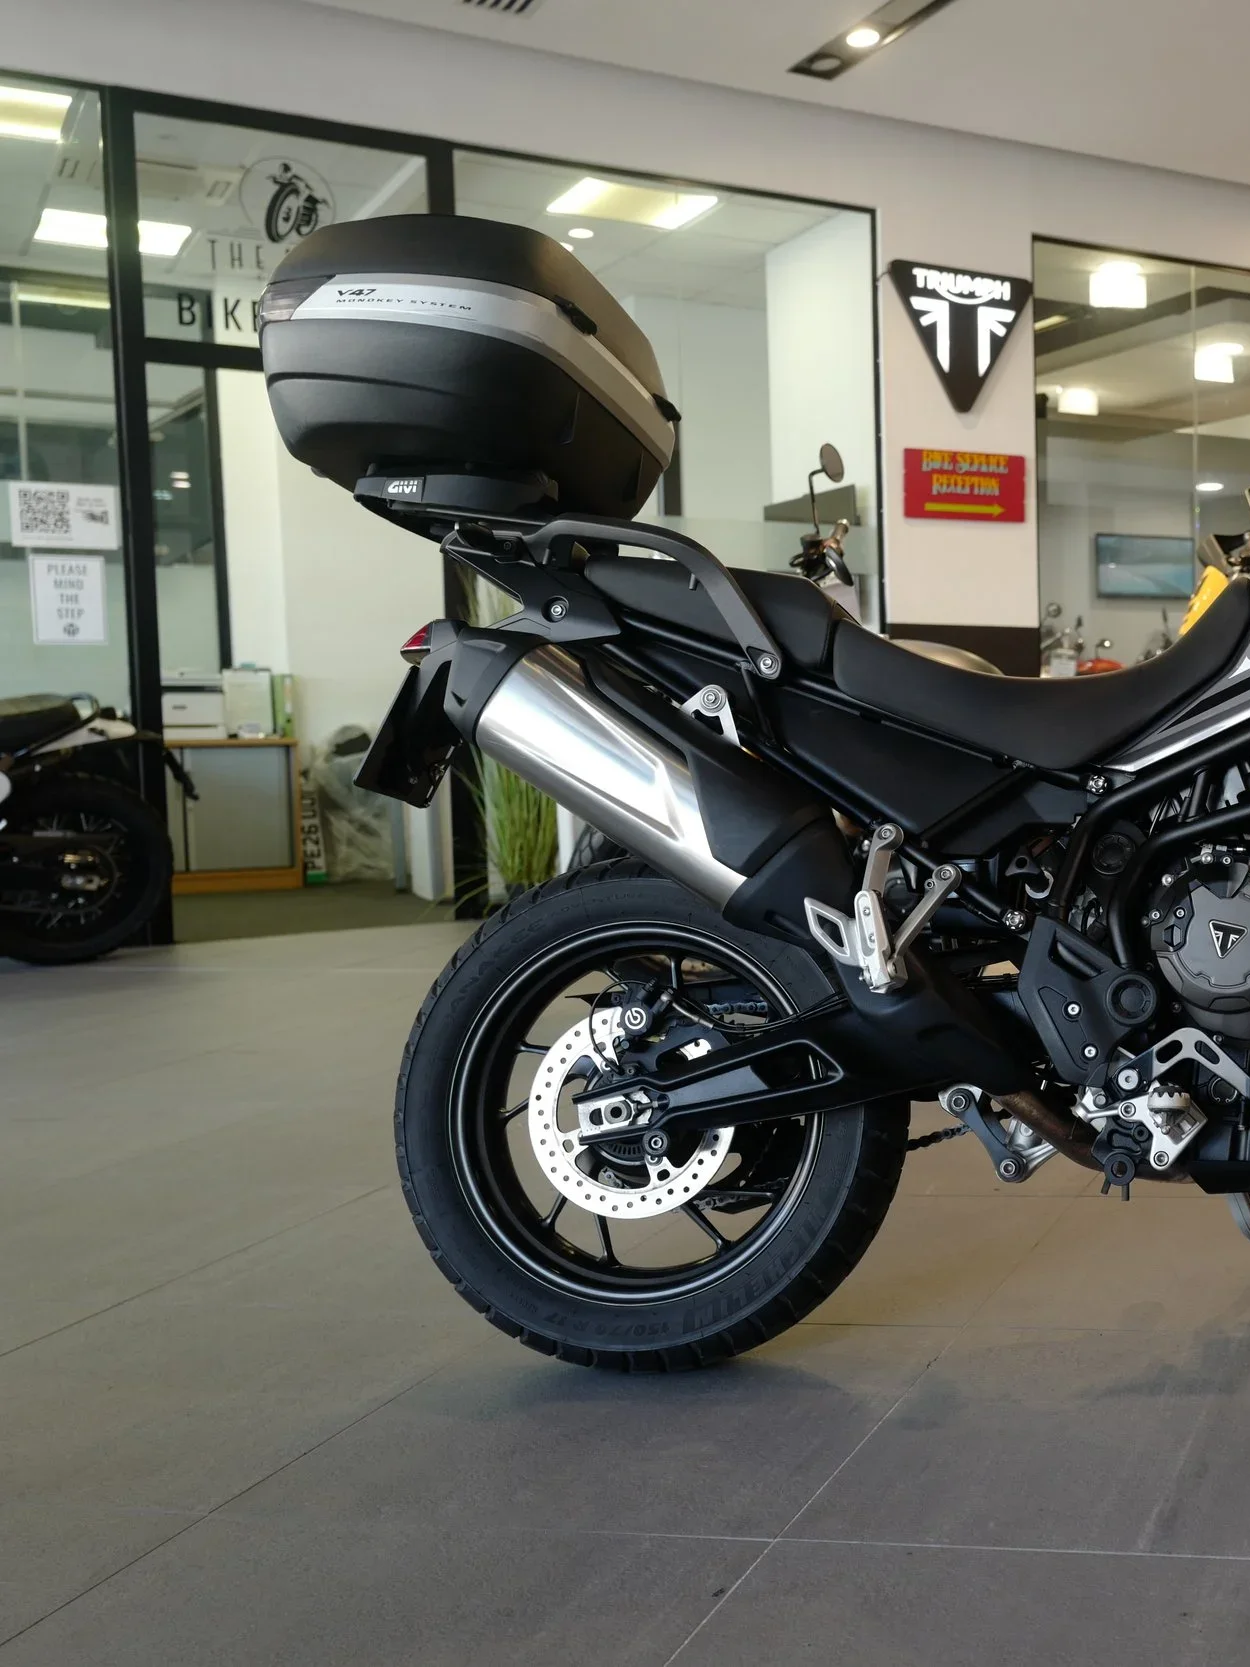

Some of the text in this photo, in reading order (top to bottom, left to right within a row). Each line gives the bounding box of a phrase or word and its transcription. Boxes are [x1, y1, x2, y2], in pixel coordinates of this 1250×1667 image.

[207, 240, 264, 270] THE
[912, 267, 1011, 302] TRIUMPH
[337, 288, 377, 297] V47
[410, 299, 472, 311] SYSTEM
[47, 563, 87, 576] PLEASE
[53, 578, 84, 590] MIND
[59, 593, 80, 604] THE
[56, 608, 84, 620] STEP
